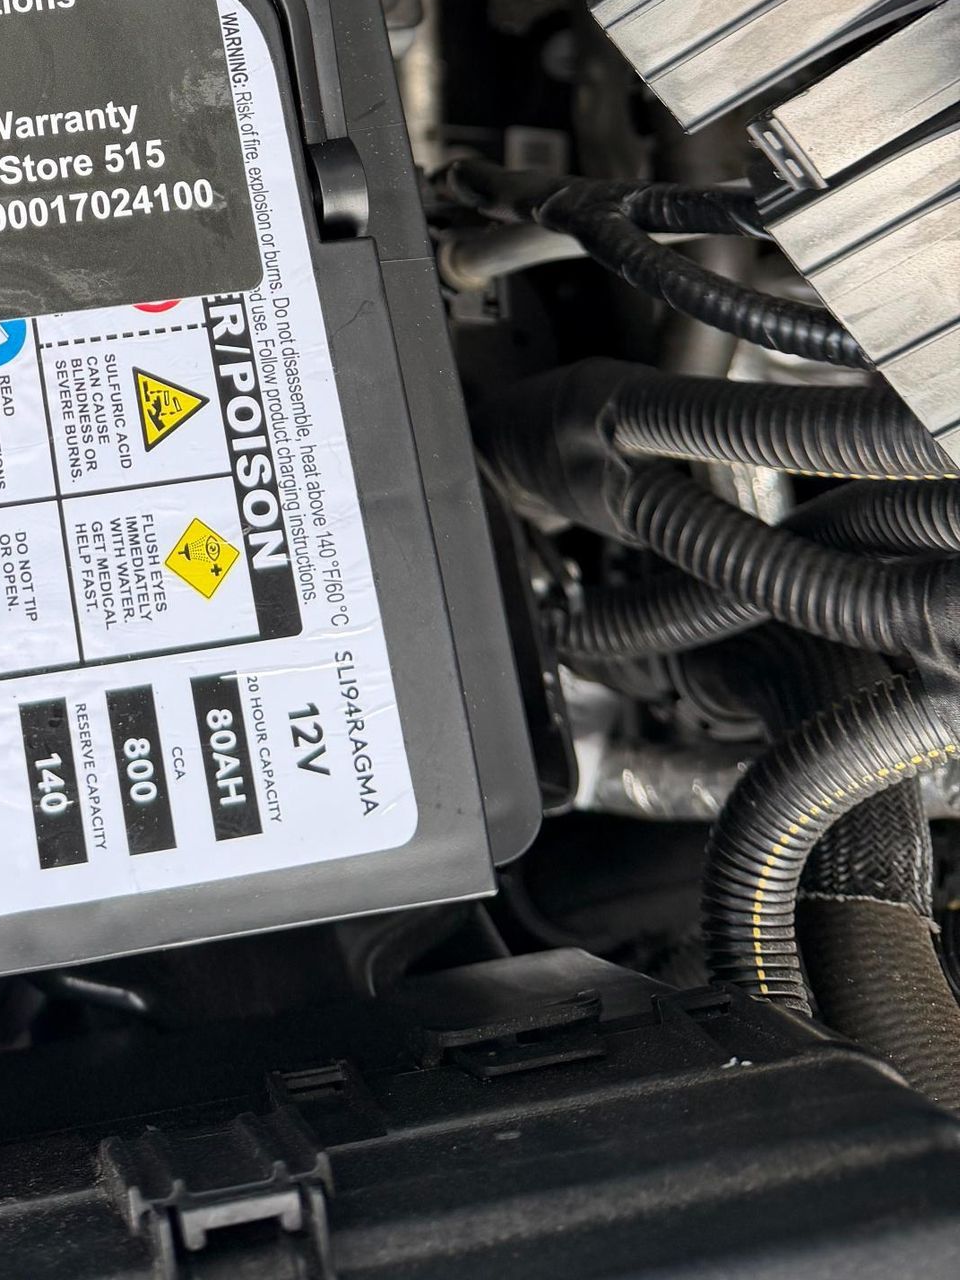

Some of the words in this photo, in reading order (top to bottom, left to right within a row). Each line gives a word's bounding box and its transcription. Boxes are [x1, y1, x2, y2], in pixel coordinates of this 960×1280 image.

[221, 12, 248, 88] WARNING:
[235, 91, 252, 121] Risk
[241, 123, 257, 137] of
[242, 138, 261, 165] fire,
[104, 139, 165, 176] 515
[248, 167, 271, 231] explosion
[260, 232, 275, 248] or
[264, 250, 282, 294] burns.
[251, 306, 267, 335] use.
[272, 297, 290, 318] Do
[277, 322, 294, 343] not
[87, 356, 102, 387] CAN
[257, 339, 277, 384] Follow
[71, 358, 94, 443] BLINDNESS
[84, 449, 98, 471] OR
[104, 354, 126, 428] SULFURIC
[116, 432, 132, 469] ACID
[262, 388, 293, 444] product
[282, 347, 313, 442] disassemble,
[56, 360, 74, 420] SEVERE
[65, 425, 82, 483] BURNS.
[92, 393, 110, 445] CAUSE
[277, 448, 302, 510] charging
[300, 445, 321, 478] heat
[306, 482, 327, 527] above
[0, 534, 12, 557] OR
[15, 531, 28, 555] DO
[75, 523, 92, 564] HELP
[91, 521, 106, 552] GET
[110, 518, 126, 558] WITH
[141, 514, 160, 565] FLUSH
[289, 514, 316, 605] instructions.
[3, 562, 19, 611] OPEN.
[19, 560, 34, 592] NOT
[82, 569, 98, 612] FAST.
[125, 516, 153, 621] IMMEDIATELY
[150, 570, 167, 612] EYES
[25, 596, 38, 621] TIP
[96, 557, 117, 631] MEDICAL
[117, 562, 135, 623] WATER.
[247, 675, 260, 692] 20
[75, 702, 96, 770] RESERVE
[251, 696, 267, 743] HOUR
[288, 702, 331, 776] 12V
[334, 650, 379, 817] SLI94RAGMA
[123, 737, 158, 804] 800
[171, 745, 186, 781] CCA
[205, 708, 247, 806] 80AH
[34, 752, 71, 815] 140
[257, 748, 282, 823] CAPACITY
[85, 774, 108, 850] CAPACITY
